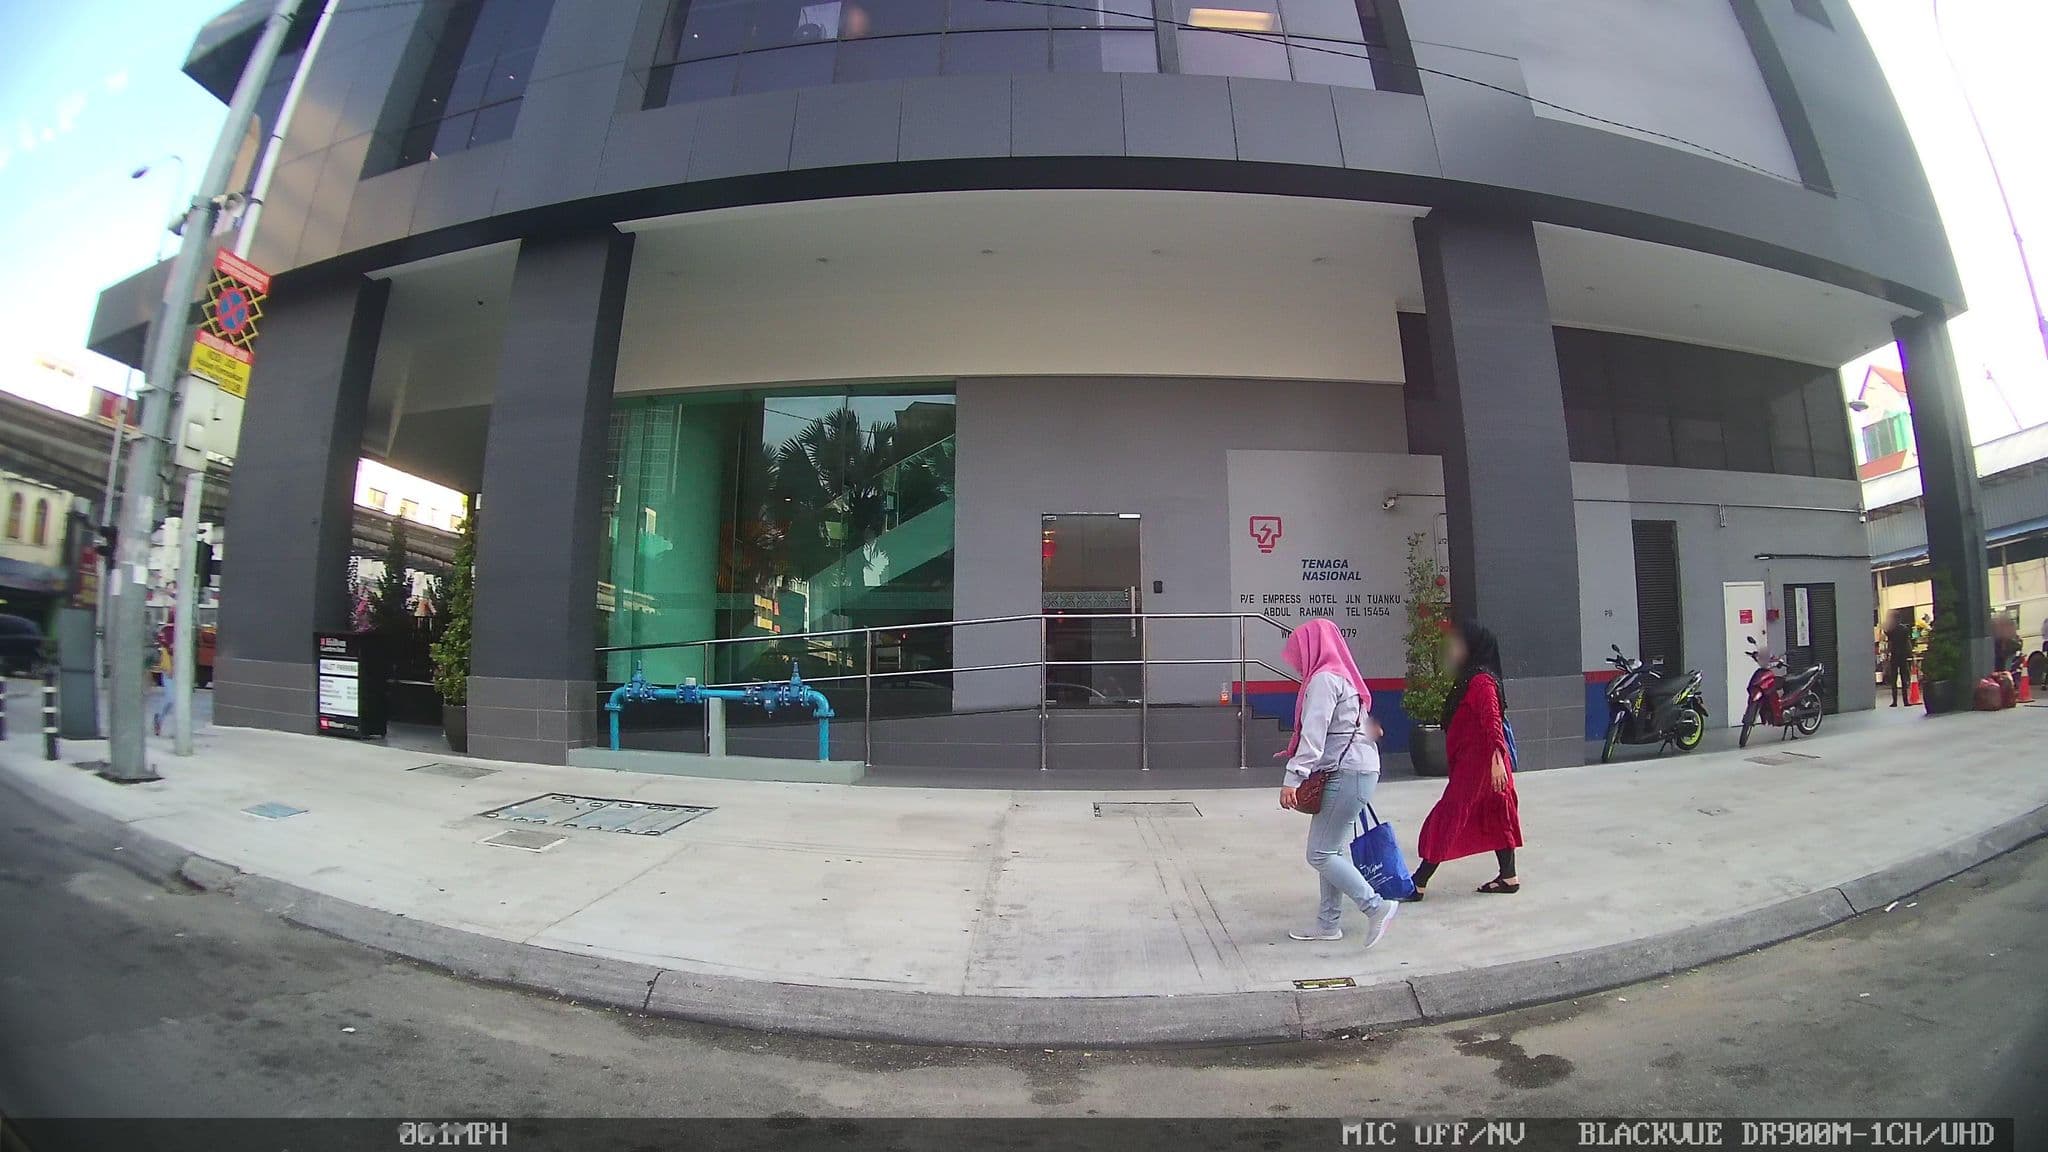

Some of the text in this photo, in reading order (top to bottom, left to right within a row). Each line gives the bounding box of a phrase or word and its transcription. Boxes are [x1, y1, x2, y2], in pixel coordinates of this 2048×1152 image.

[1301, 559, 1349, 569] TENAGA
[1302, 571, 1362, 581] NASIONAL
[1240, 594, 1401, 604] P/E EMPRESS HOTEL JLN TUANKU
[1263, 607, 1390, 617] ABDUL RAHMAN TEL 15454
